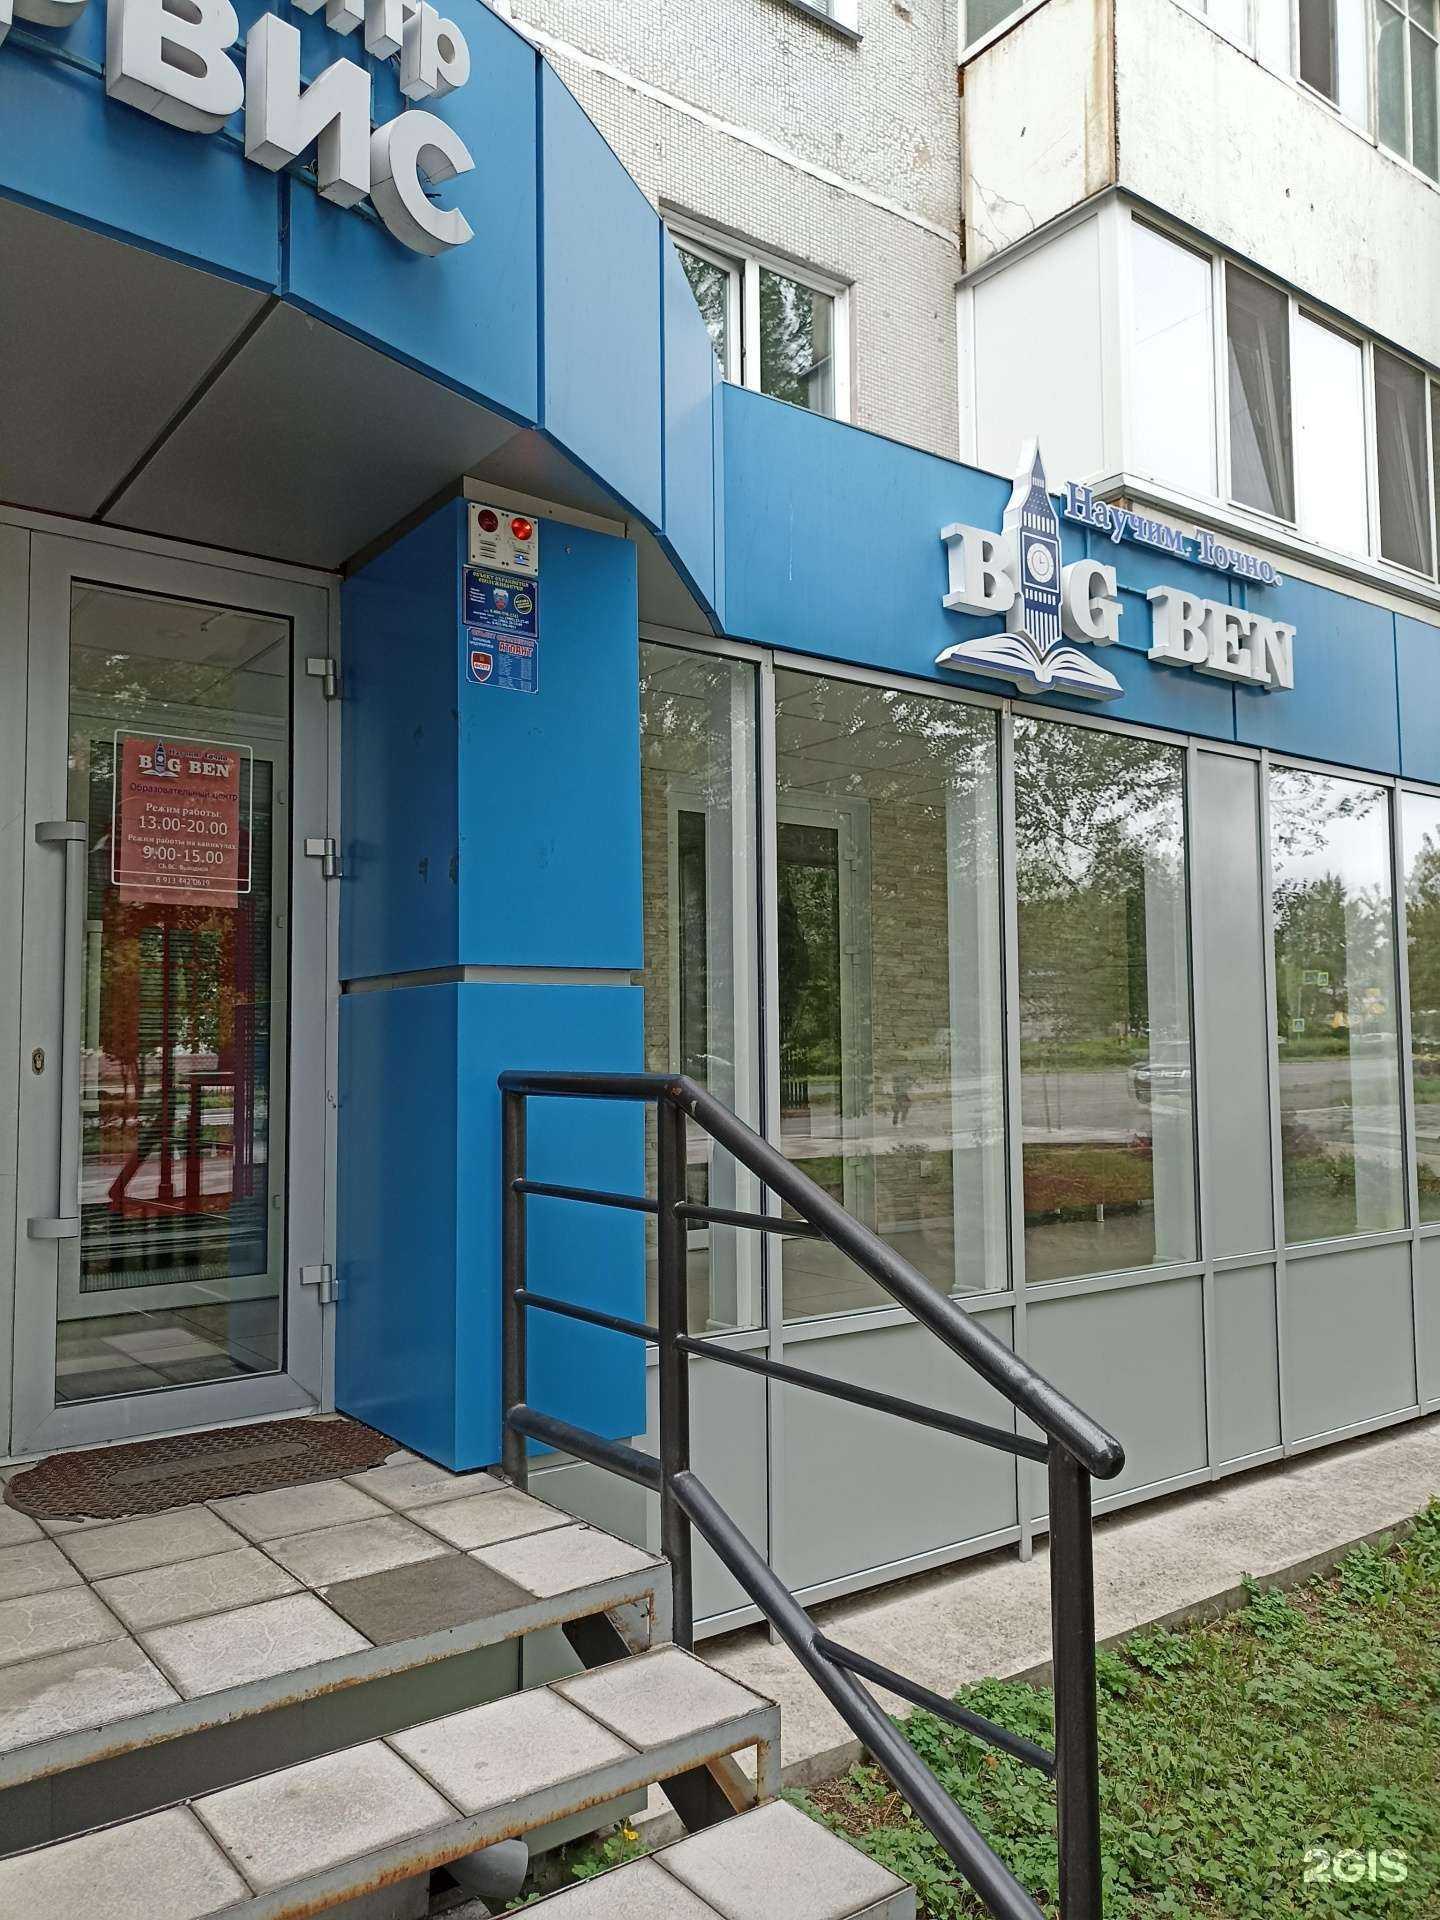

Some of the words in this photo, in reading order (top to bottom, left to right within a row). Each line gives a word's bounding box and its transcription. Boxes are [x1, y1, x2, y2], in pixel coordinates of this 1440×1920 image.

[1195, 527, 1283, 587] Точно.
[1146, 585, 1297, 692] BEN
[189, 760, 230, 778] BEN
[146, 803, 180, 815] Режим
[139, 815, 228, 836] 13.00-20.00
[128, 833, 155, 843] Режим
[156, 837, 183, 847] работы
[142, 845, 224, 865] 9.00-15.00
